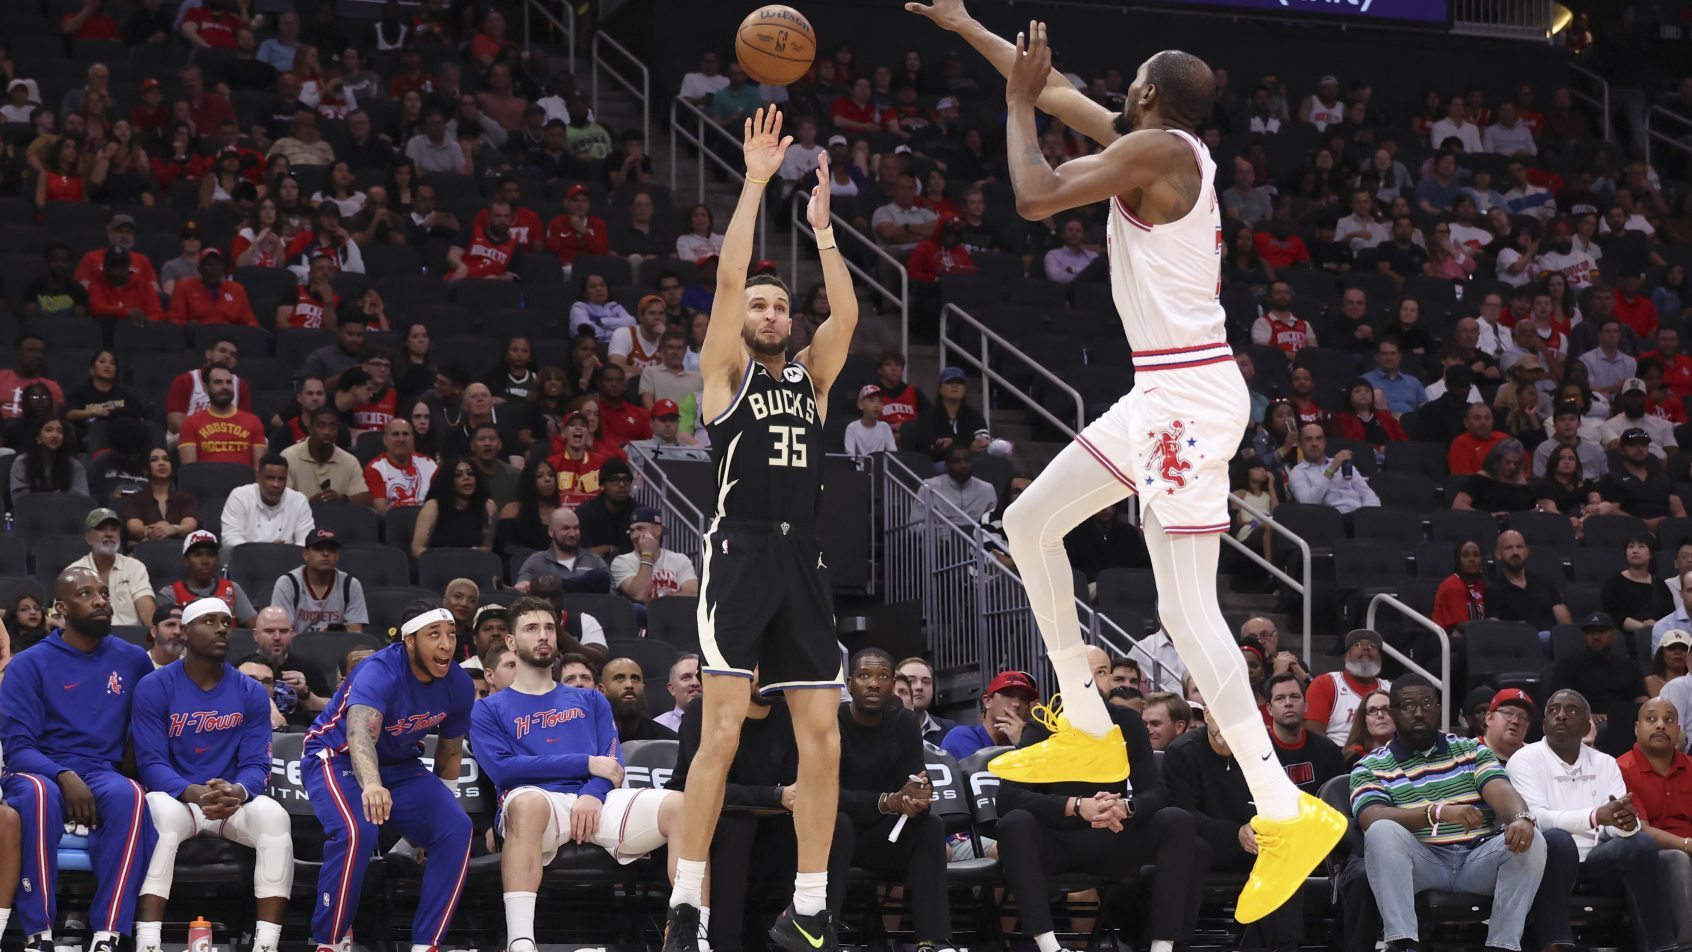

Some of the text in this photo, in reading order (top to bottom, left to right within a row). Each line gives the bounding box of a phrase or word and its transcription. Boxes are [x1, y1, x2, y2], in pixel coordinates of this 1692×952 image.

[761, 10, 810, 32] Wilson
[748, 389, 815, 425] BUCKS
[199, 422, 251, 438] HOUSTON
[202, 441, 250, 453] ROCKETS
[769, 425, 807, 468] 35
[298, 609, 341, 621] ROCKETS
[170, 711, 244, 737] H-Town
[514, 708, 585, 740] H-Town
